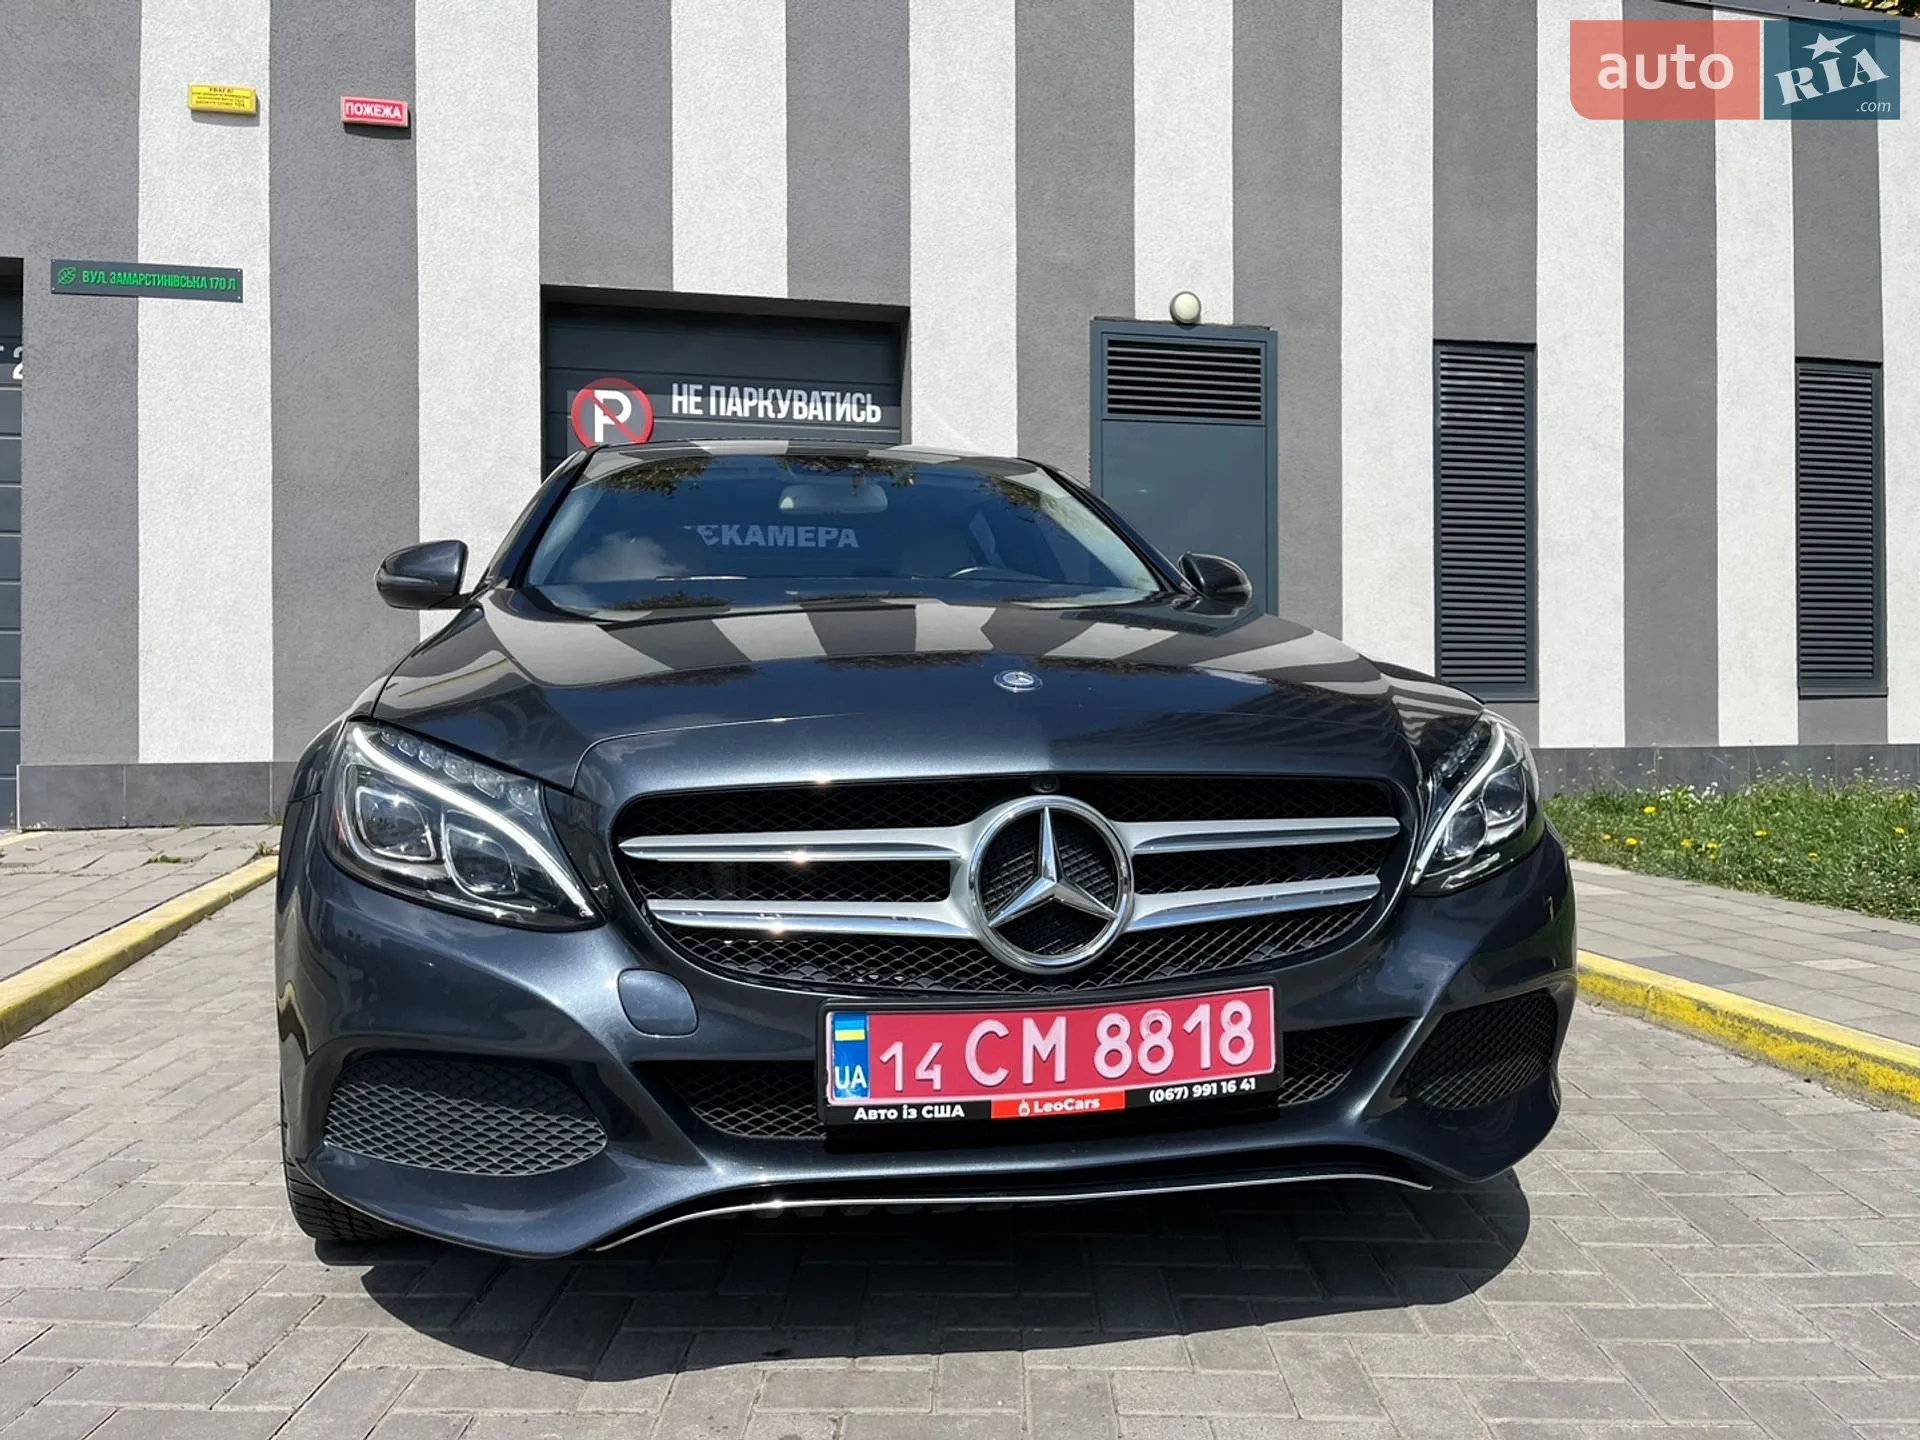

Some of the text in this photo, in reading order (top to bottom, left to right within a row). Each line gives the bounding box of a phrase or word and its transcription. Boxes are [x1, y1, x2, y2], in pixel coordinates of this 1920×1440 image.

[345, 103, 401, 119] ПОЖЕЖА
[82, 270, 237, 290] ВУЛ. ЗАМАРСТИНІВСЬКА 170 Л
[671, 383, 882, 424] НЕ ПАРКУВАТИСЬ
[682, 524, 860, 549] ЕКАМЕРА
[879, 999, 1256, 1092] 14 CM 8818
[834, 1065, 868, 1090] UA
[1149, 1077, 1256, 1103] (067) 991 16 41
[853, 1103, 966, 1121] Авто із США
[1033, 1097, 1100, 1114] LeoCars
